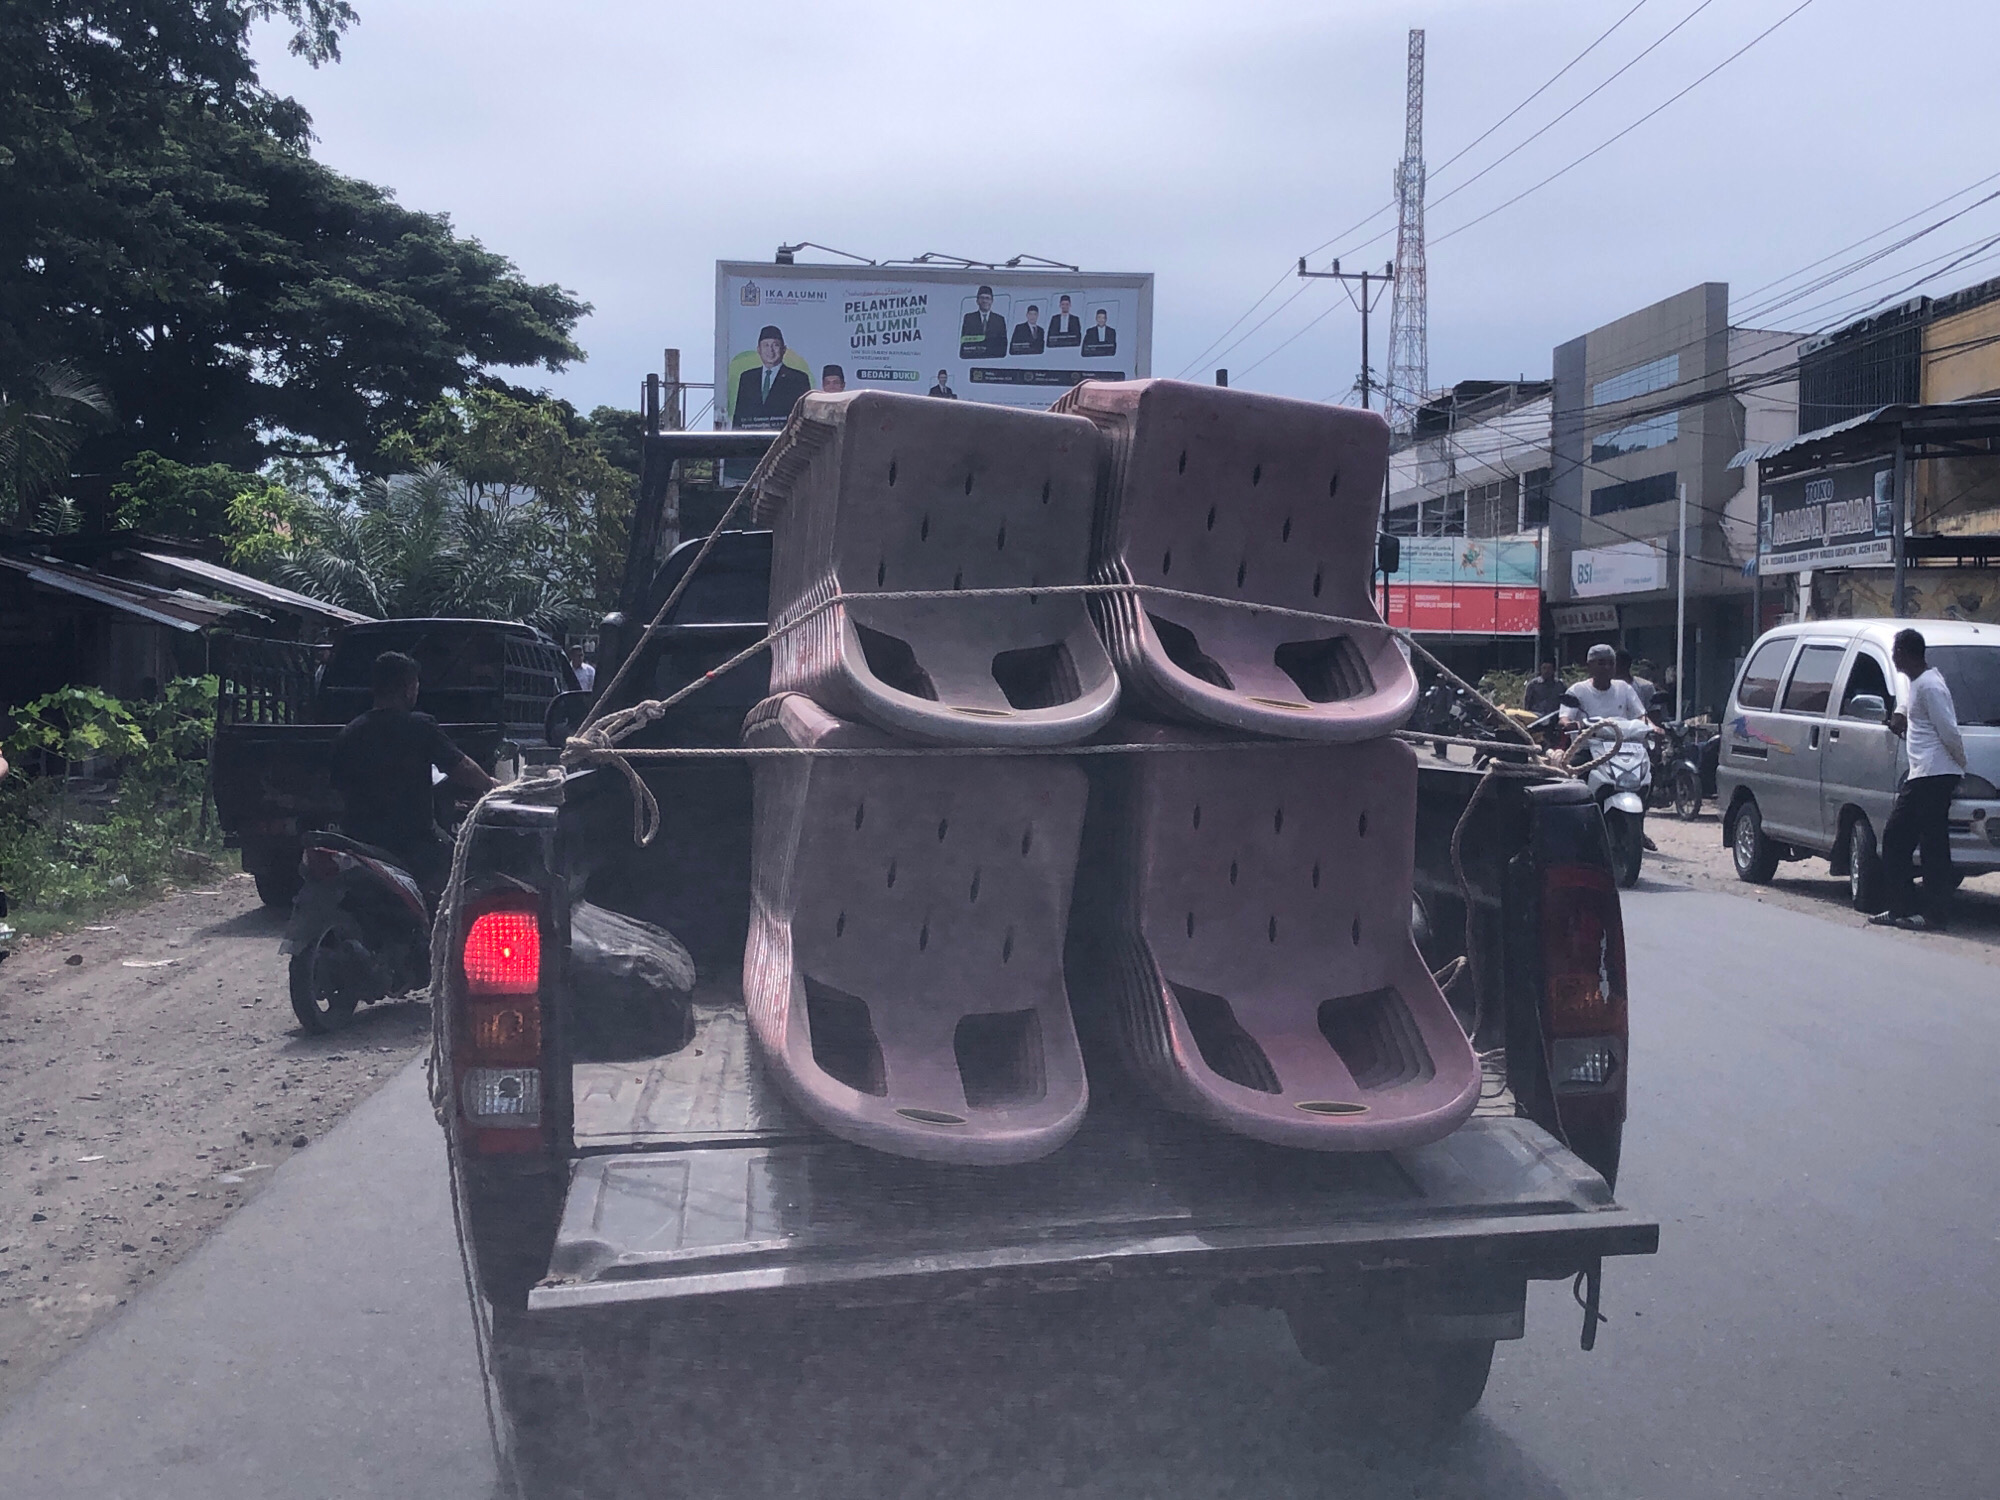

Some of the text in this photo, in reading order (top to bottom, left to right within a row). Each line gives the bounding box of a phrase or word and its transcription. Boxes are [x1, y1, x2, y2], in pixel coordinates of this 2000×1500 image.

[765, 290, 827, 299] IKA ALUMNI
[844, 294, 928, 313] PELANTIKAN
[844, 307, 927, 323] IKATAN KELUARGA
[855, 317, 918, 335] ALUMNI
[850, 329, 922, 348] UIN SUNA
[861, 370, 917, 380] BEDAH BUKU
[1805, 478, 1834, 504] TOKO
[1578, 560, 1593, 584] BSI
